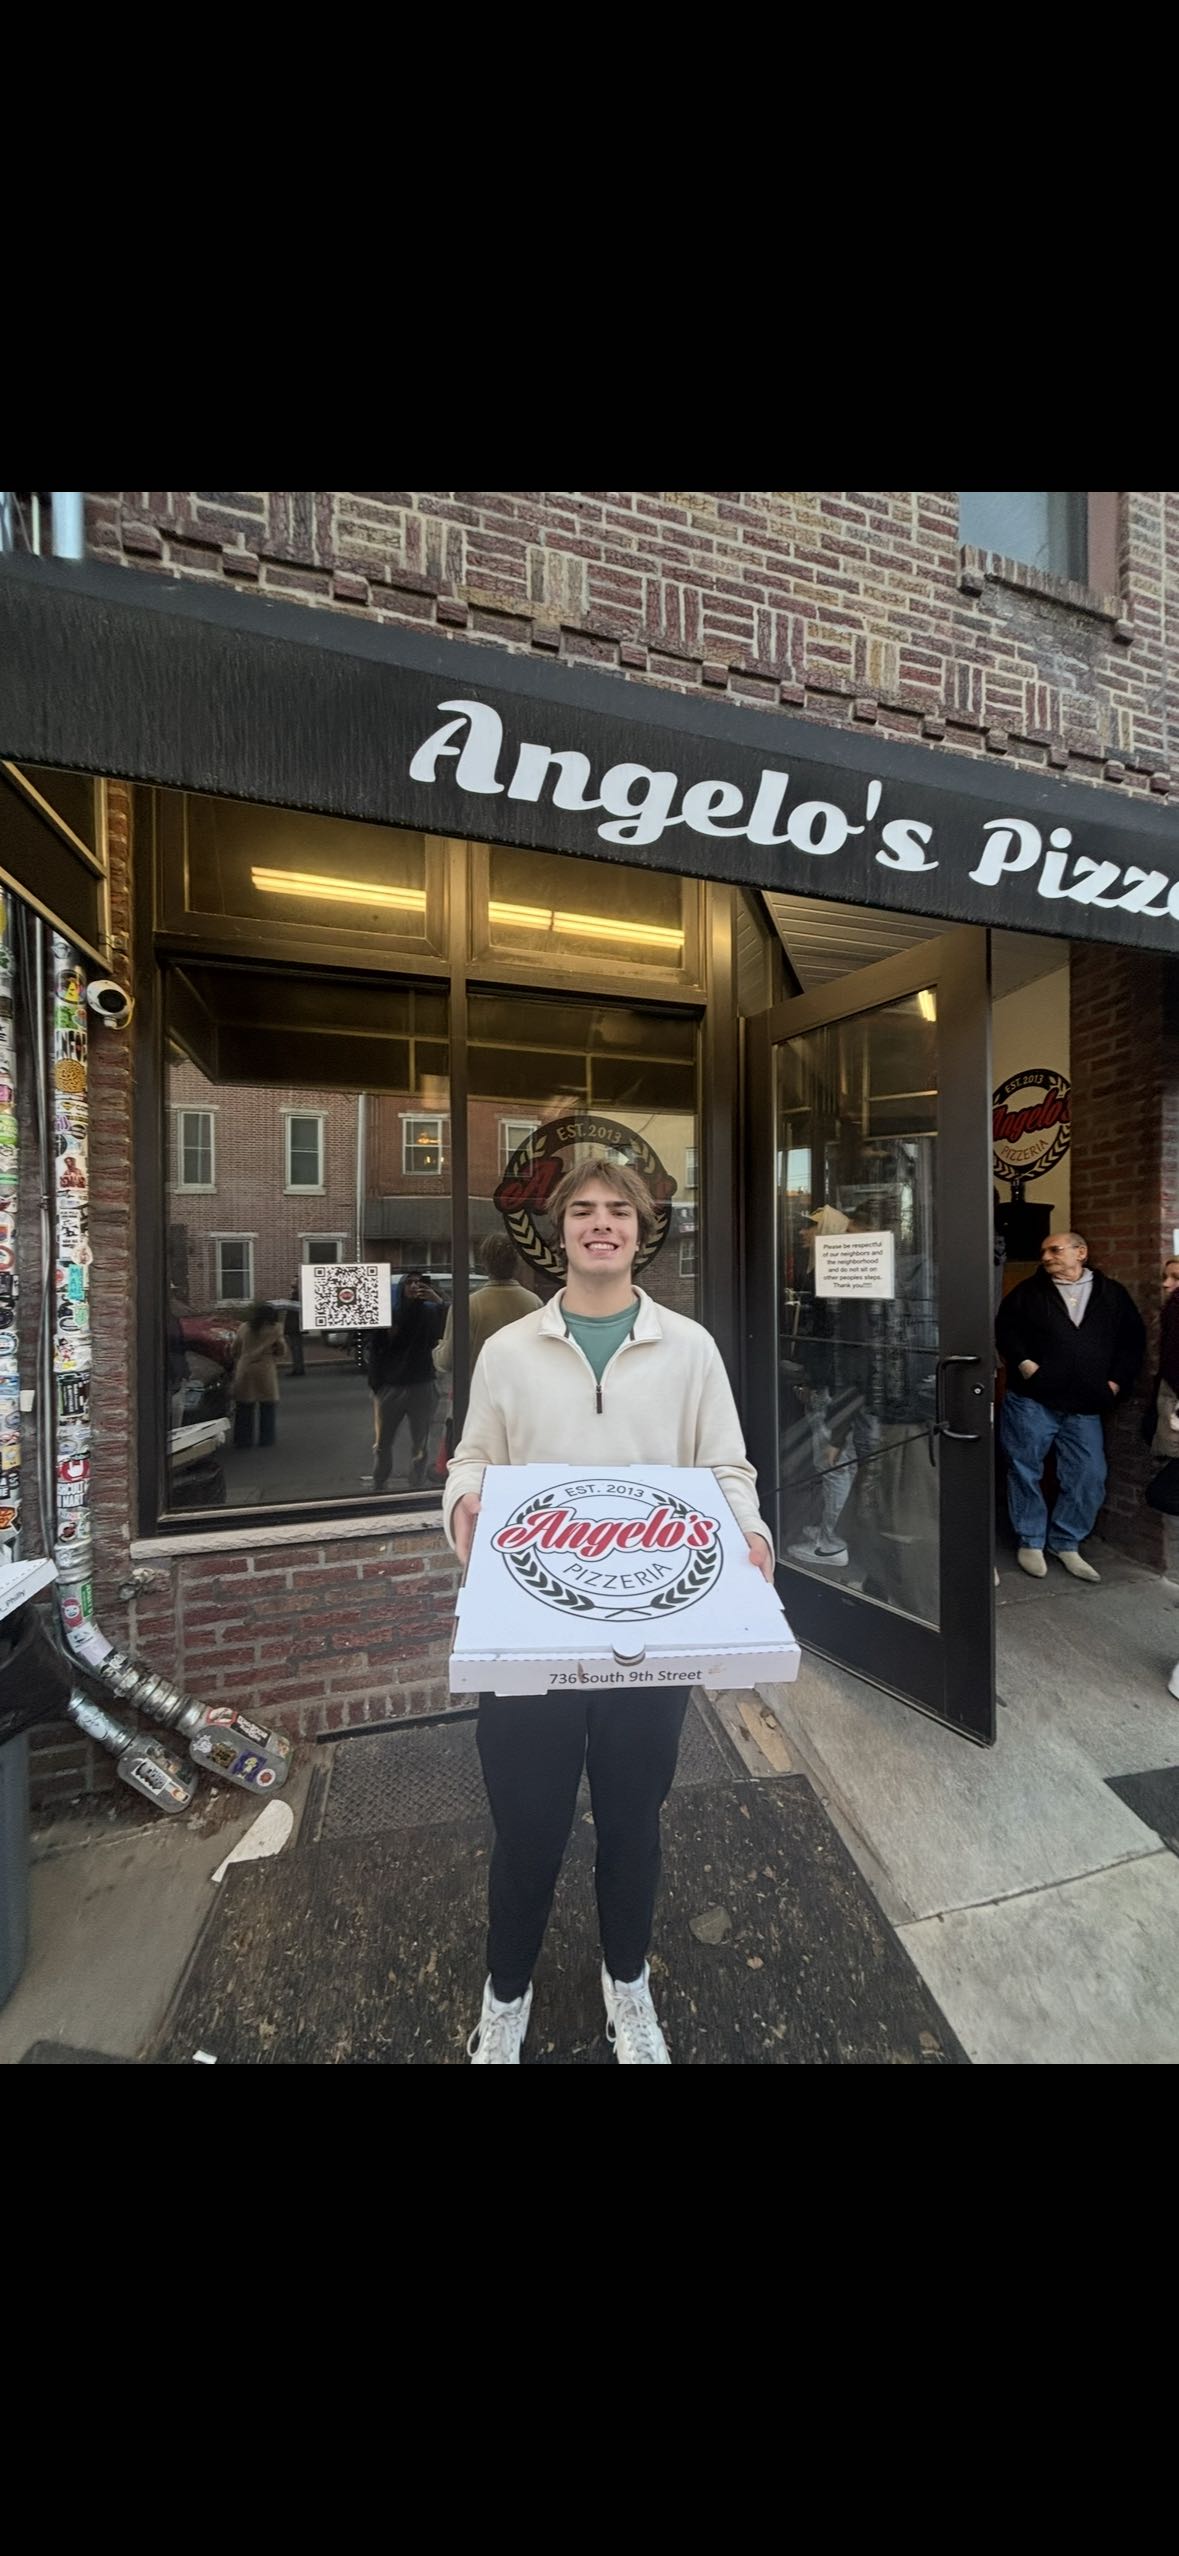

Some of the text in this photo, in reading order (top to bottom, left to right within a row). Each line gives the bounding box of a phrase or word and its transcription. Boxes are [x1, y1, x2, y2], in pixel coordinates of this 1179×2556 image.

[410, 699, 939, 873] Angelo's
[1000, 1139, 1049, 1161] PIZZERIA
[852, 1241, 882, 1249] respectful
[564, 1483, 645, 1498] EST. 2013
[496, 1508, 714, 1558] Angelo's
[563, 1563, 673, 1590] PIZZERIA
[549, 1668, 703, 1685] 736 South 9th Street
